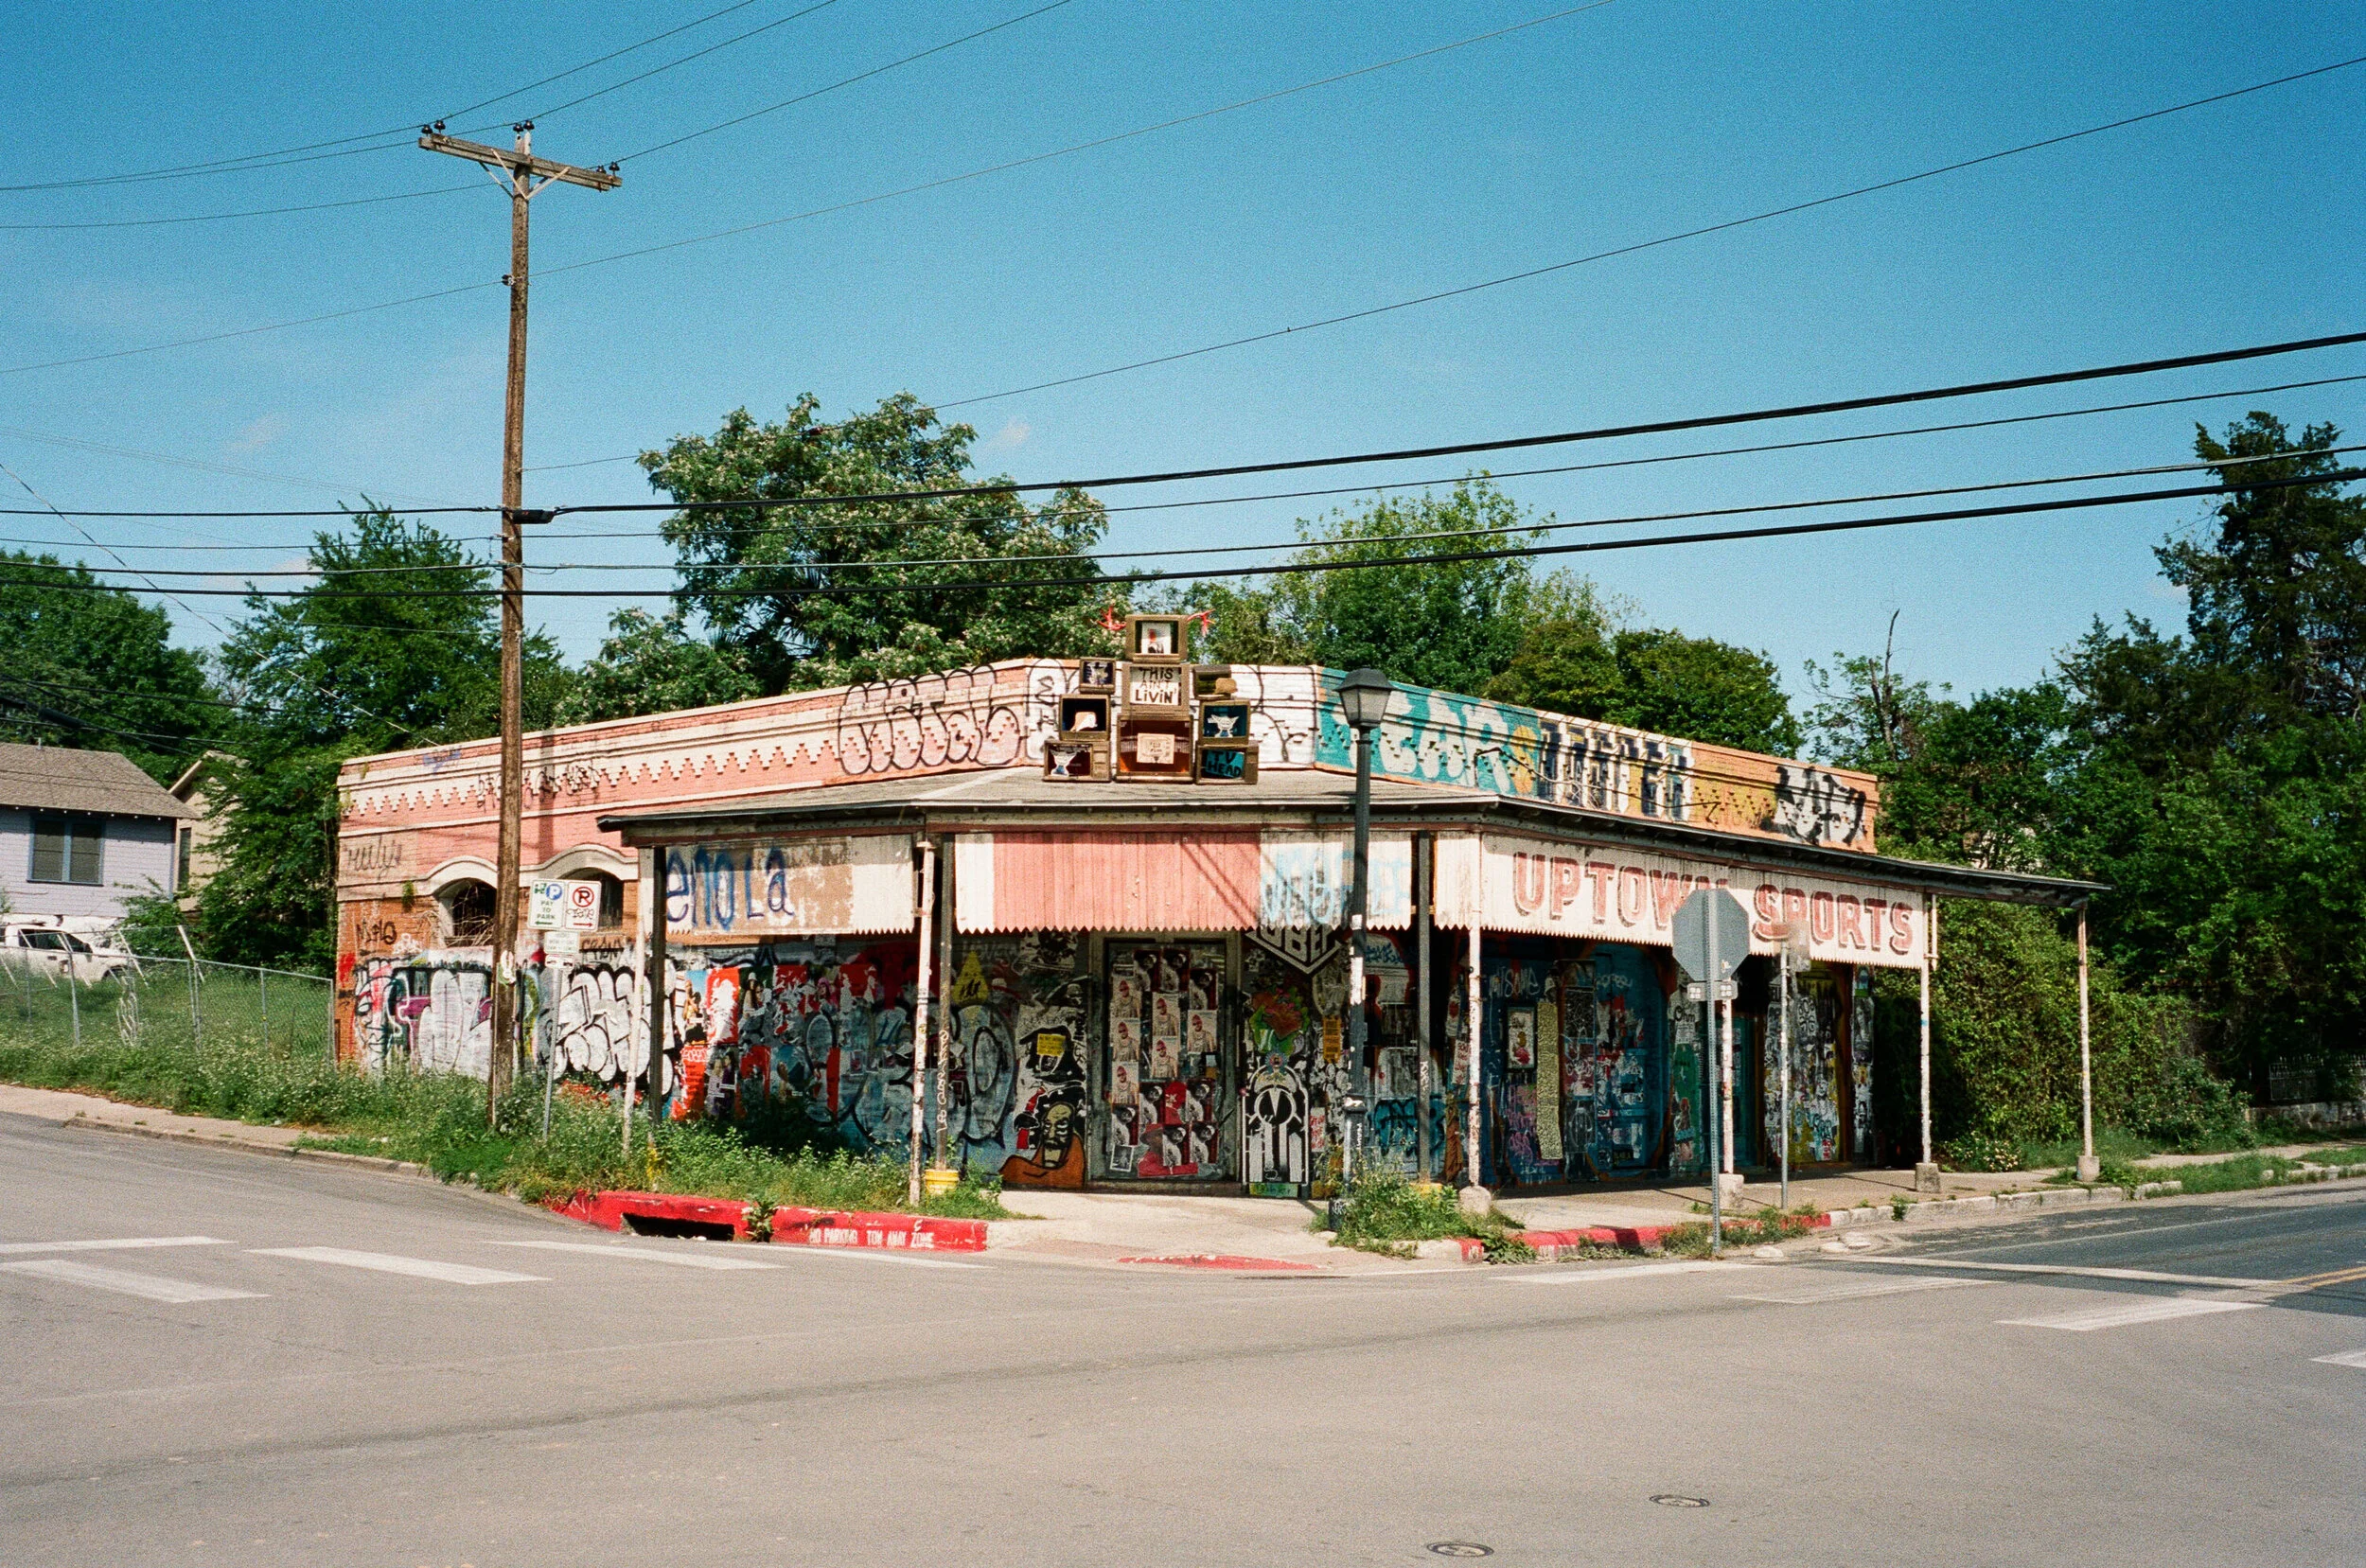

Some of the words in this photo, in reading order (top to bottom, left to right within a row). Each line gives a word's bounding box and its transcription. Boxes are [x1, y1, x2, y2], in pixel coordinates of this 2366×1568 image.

[1213, 750, 1236, 761] TV
[1208, 760, 1242, 777] HEAD
[1513, 852, 1728, 931] UPTOW
[1752, 883, 1914, 956] SPORTS
[809, 1228, 821, 1243] NO
[823, 1228, 858, 1244] PARKING
[866, 1229, 883, 1246] TOW
[887, 1230, 908, 1247] AWAY
[910, 1232, 935, 1249] ZONE
